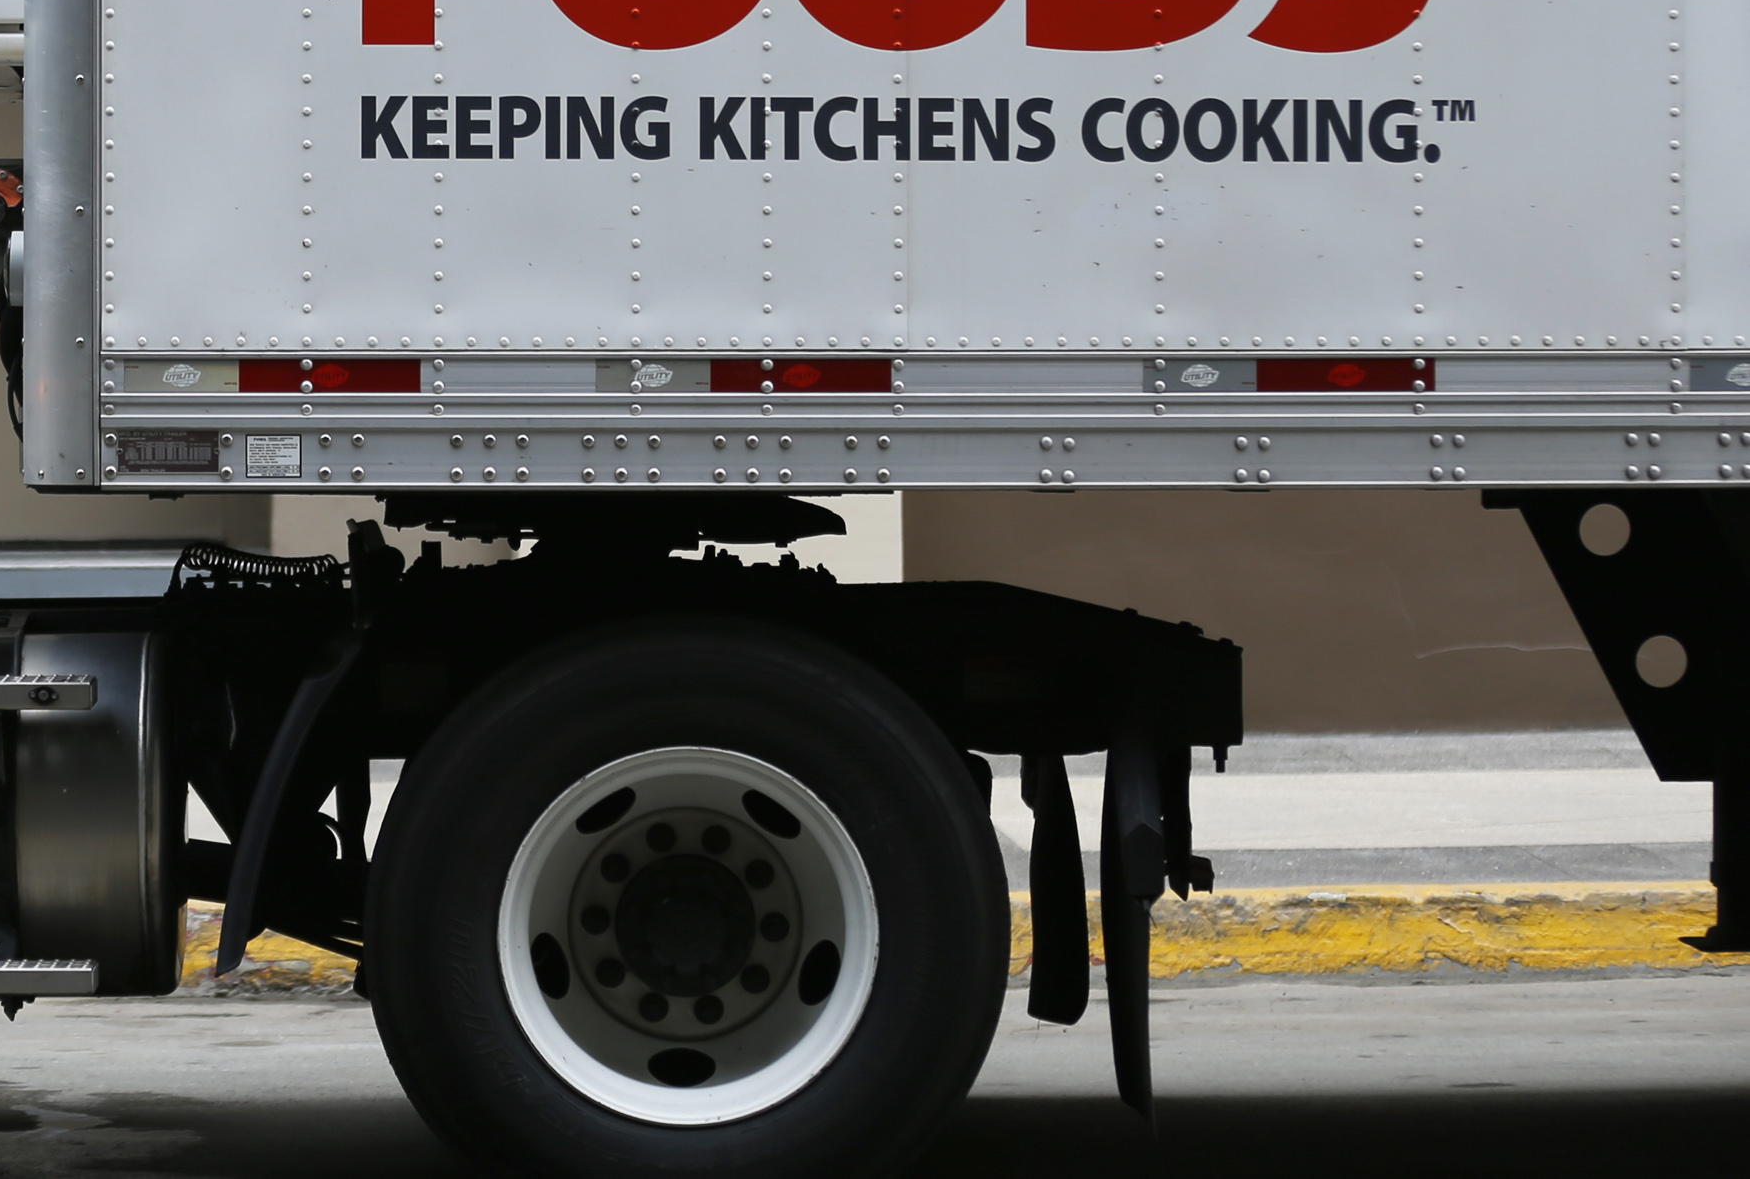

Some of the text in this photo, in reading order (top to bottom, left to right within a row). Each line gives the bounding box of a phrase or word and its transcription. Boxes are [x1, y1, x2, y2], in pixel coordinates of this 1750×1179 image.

[361, 95, 671, 161] KEEPING
[699, 96, 1056, 163] KITCHENS
[165, 371, 199, 382] UTILITY
